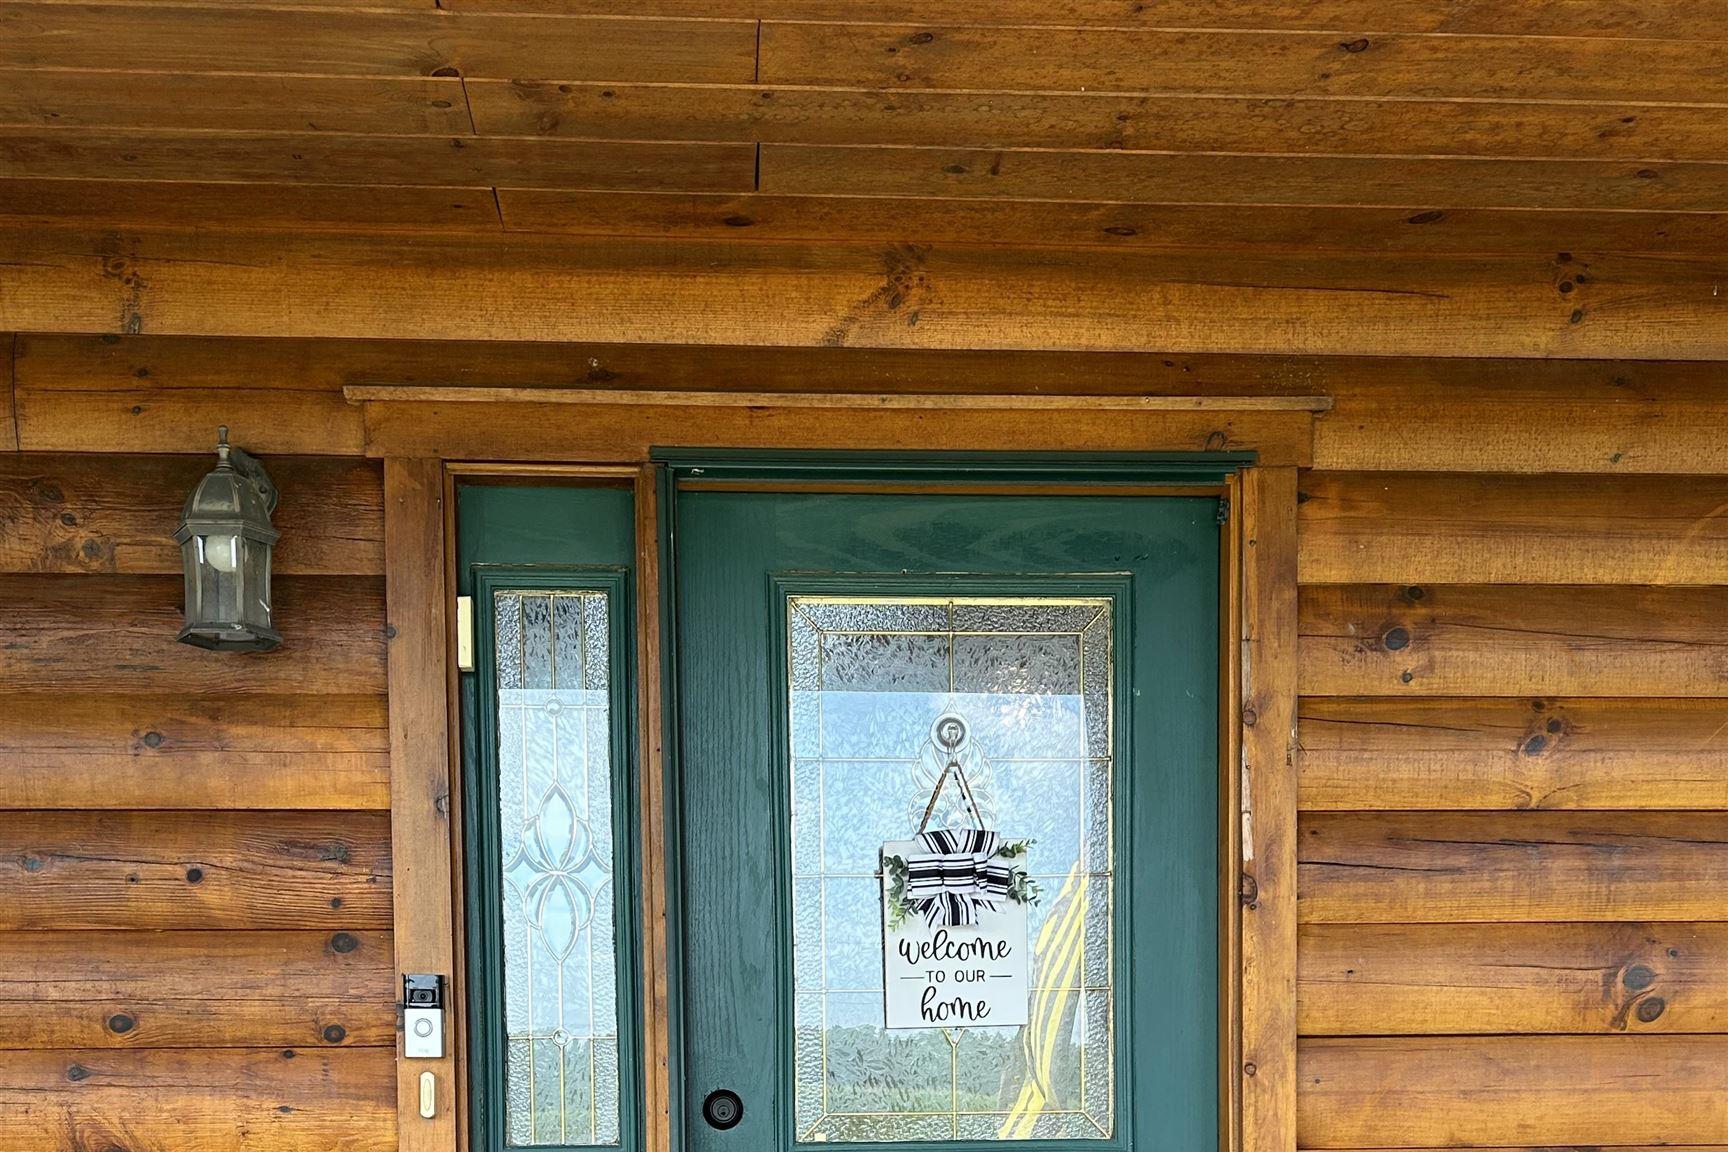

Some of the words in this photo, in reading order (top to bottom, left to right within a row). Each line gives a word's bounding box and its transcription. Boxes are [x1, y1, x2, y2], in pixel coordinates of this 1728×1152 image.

[899, 929, 1012, 965] welcome
[925, 970, 946, 983] TO
[954, 970, 986, 983] OUR
[921, 986, 991, 1022] home
